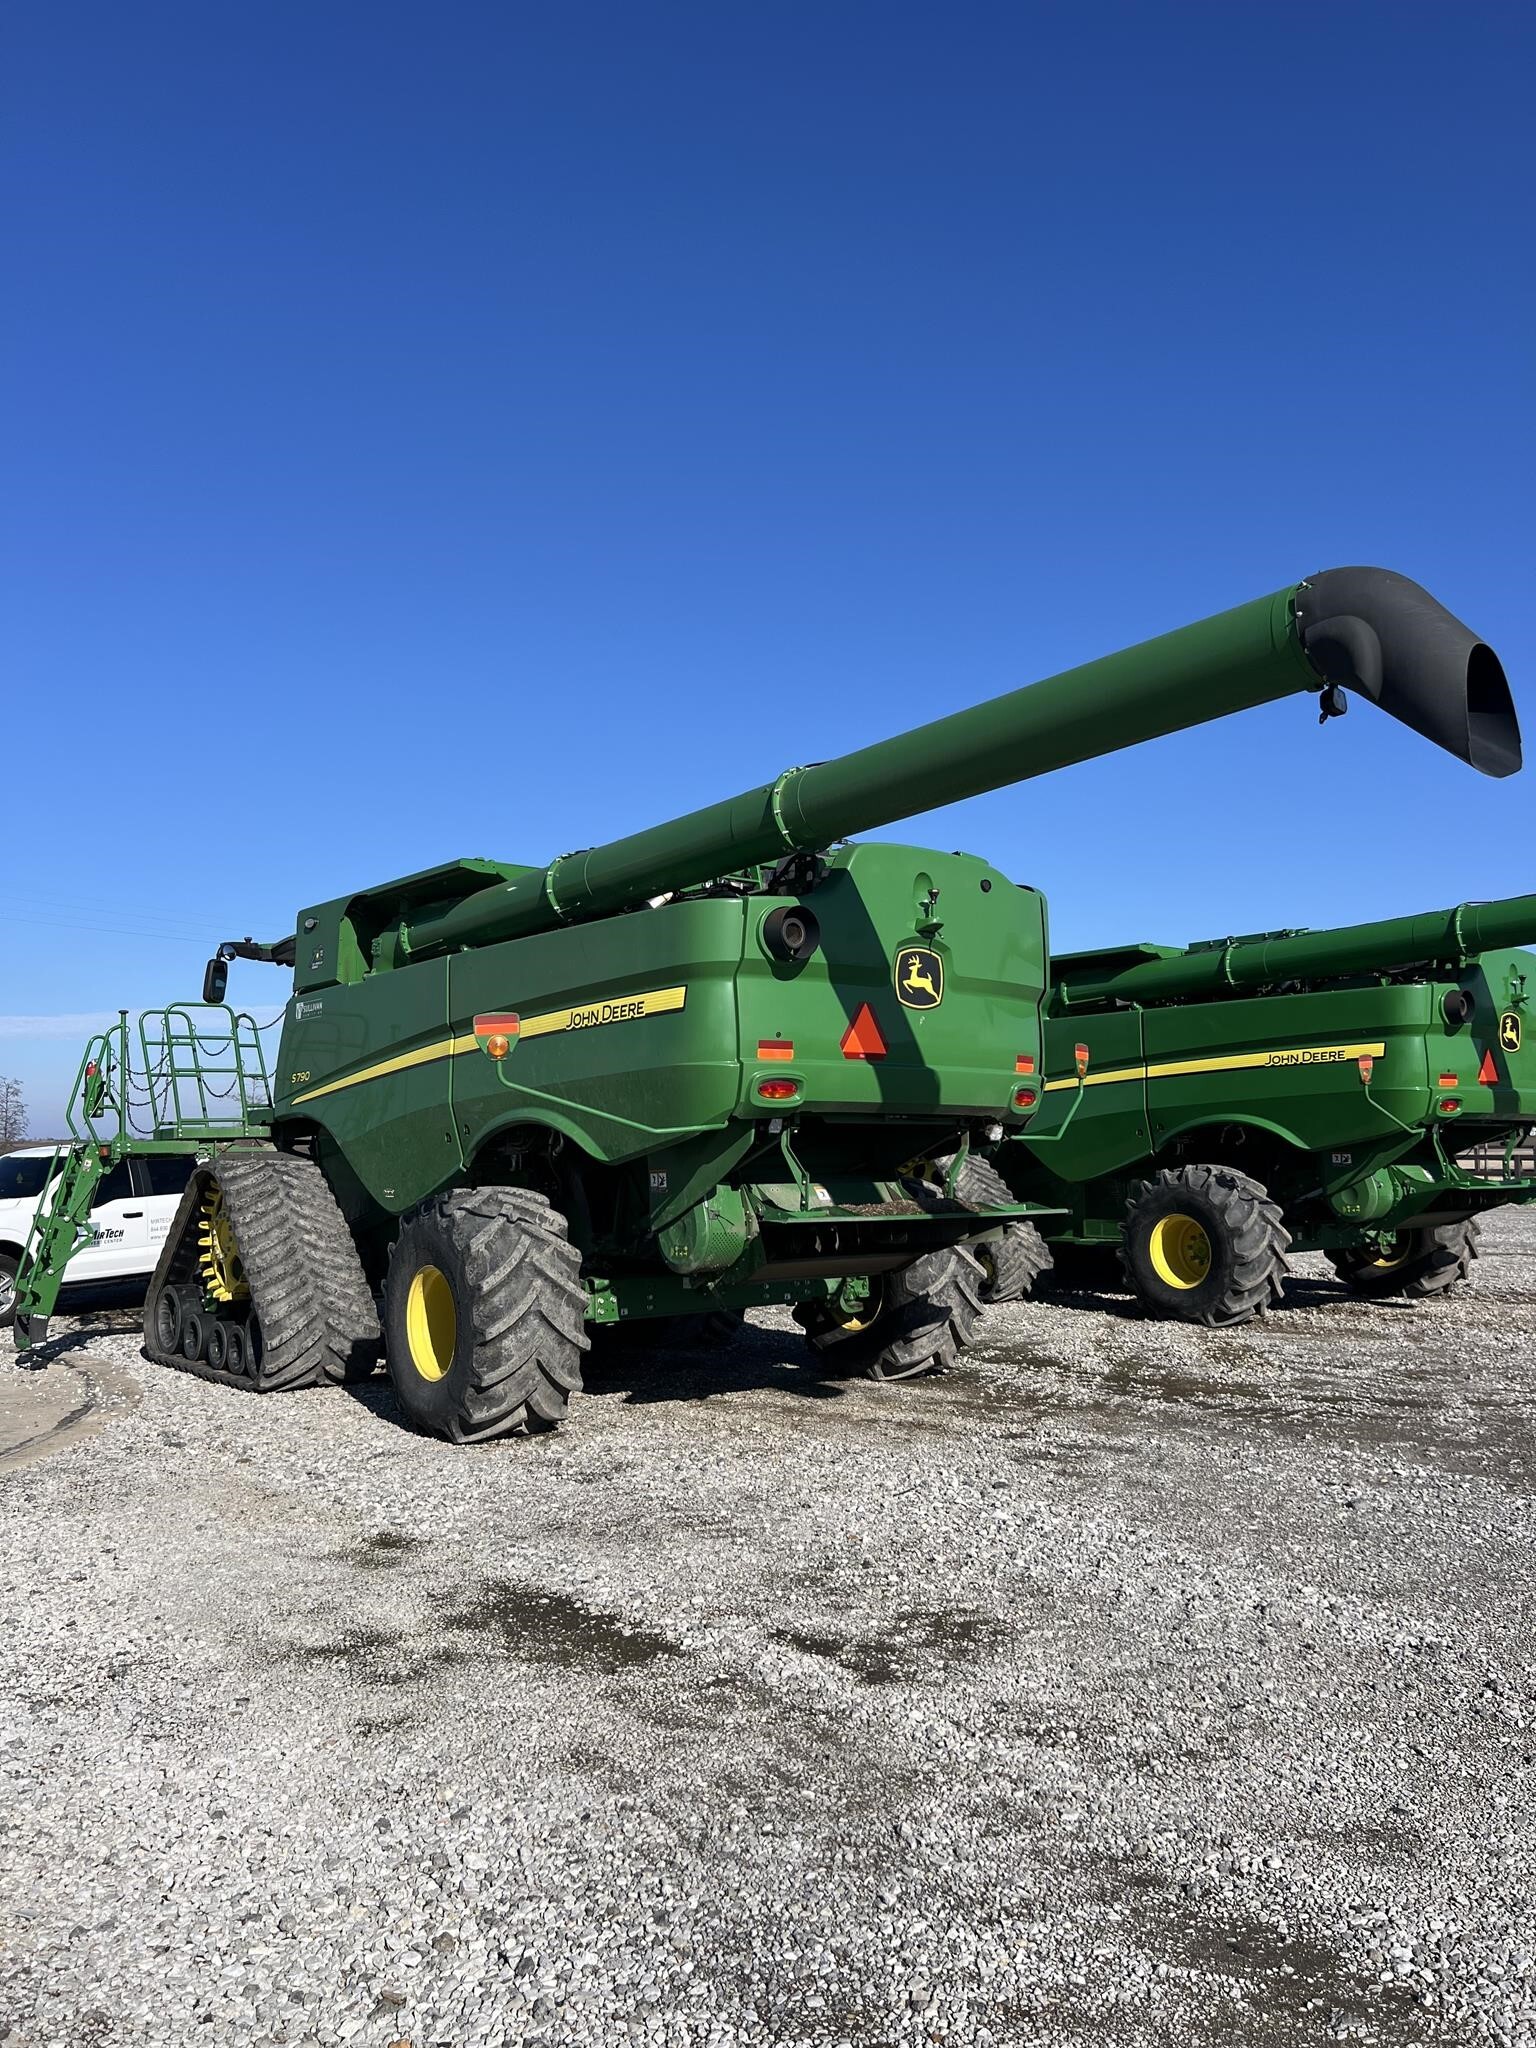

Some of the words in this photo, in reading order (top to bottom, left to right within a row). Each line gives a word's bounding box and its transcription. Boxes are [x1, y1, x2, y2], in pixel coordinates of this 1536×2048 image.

[565, 1009, 600, 1029] JOHN
[601, 1000, 646, 1022] DEERE
[1265, 1053, 1300, 1066] JOHN
[1301, 1049, 1347, 1063] DEERE
[291, 1070, 311, 1084] S790
